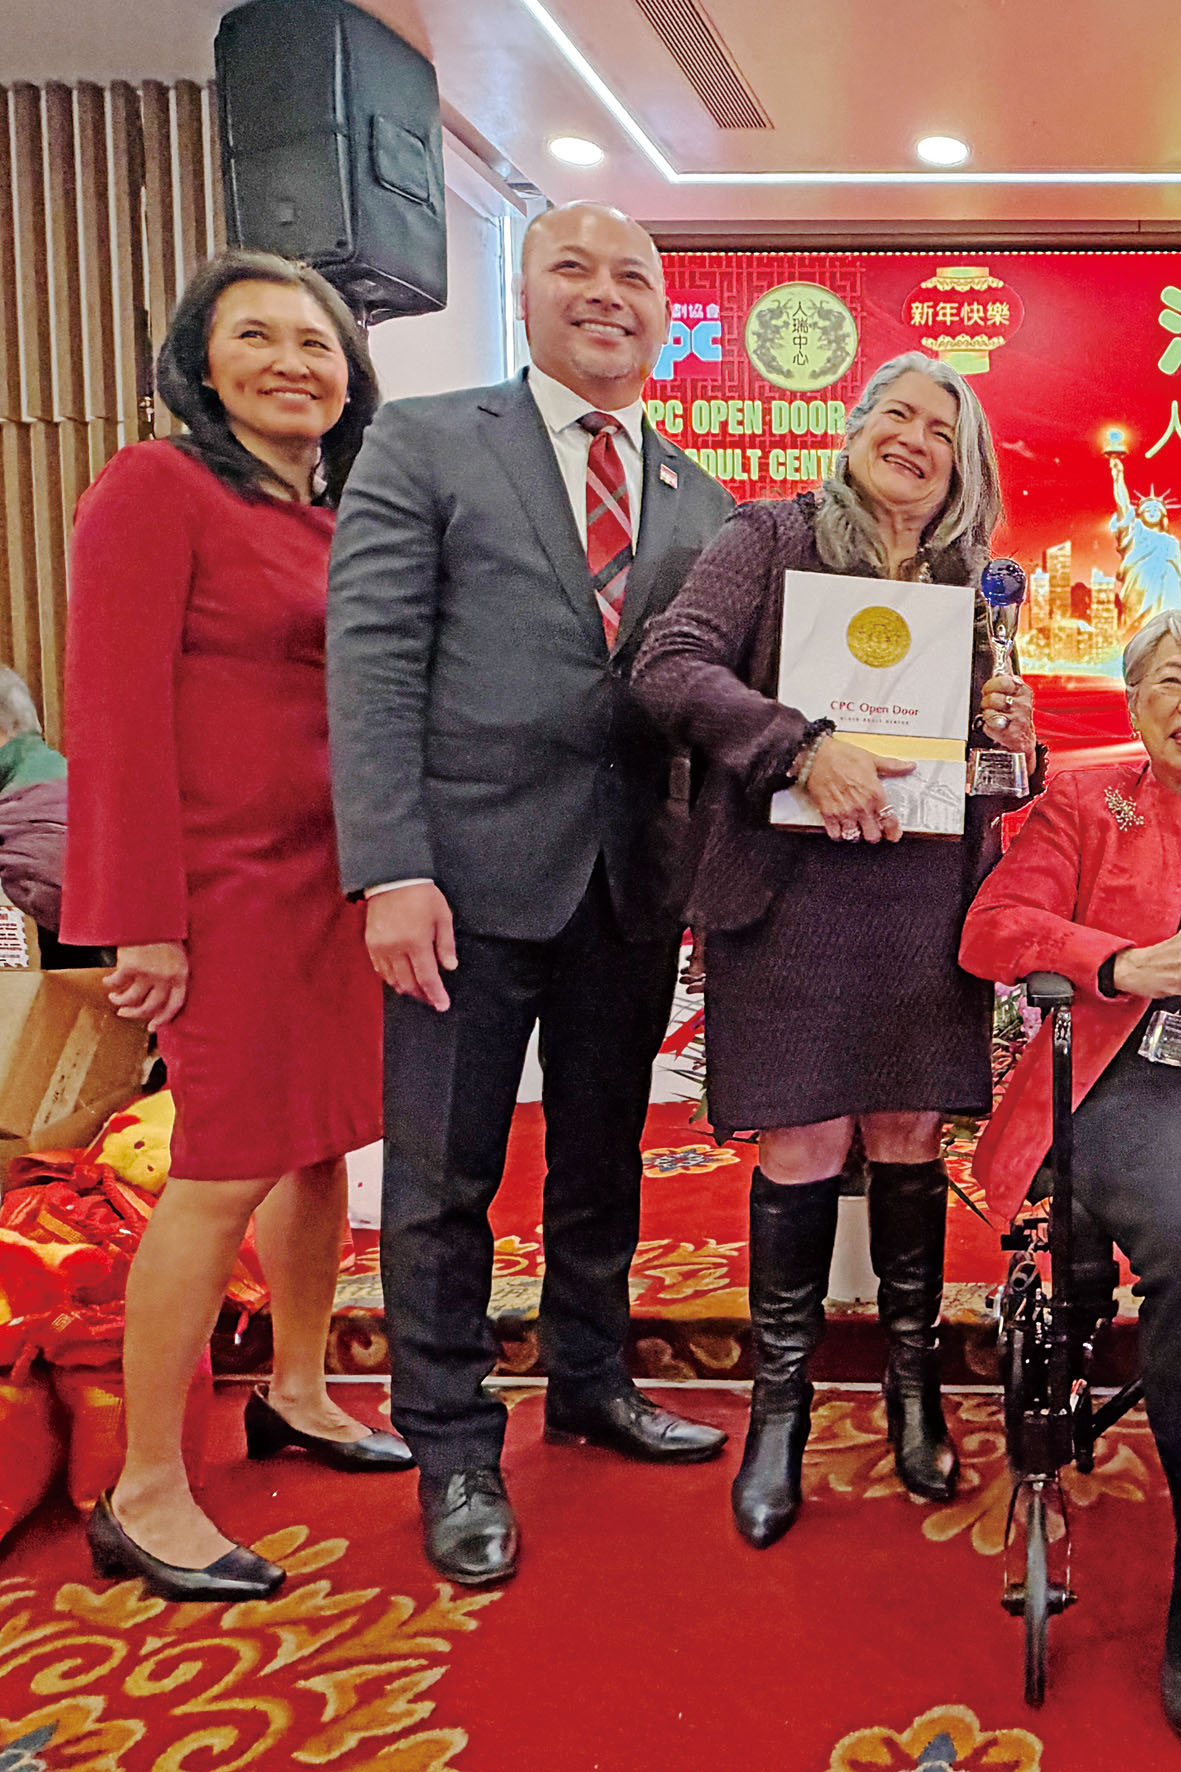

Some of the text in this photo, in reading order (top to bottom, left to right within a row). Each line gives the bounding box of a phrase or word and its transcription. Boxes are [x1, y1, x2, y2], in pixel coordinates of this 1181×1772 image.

[910, 300, 1011, 327] 新年快樂
[792, 301, 809, 366] 人瑞中心
[647, 399, 846, 434] PC OPEN DOOR
[769, 449, 842, 481] CENT
[830, 700, 919, 716] CPC Open Door
